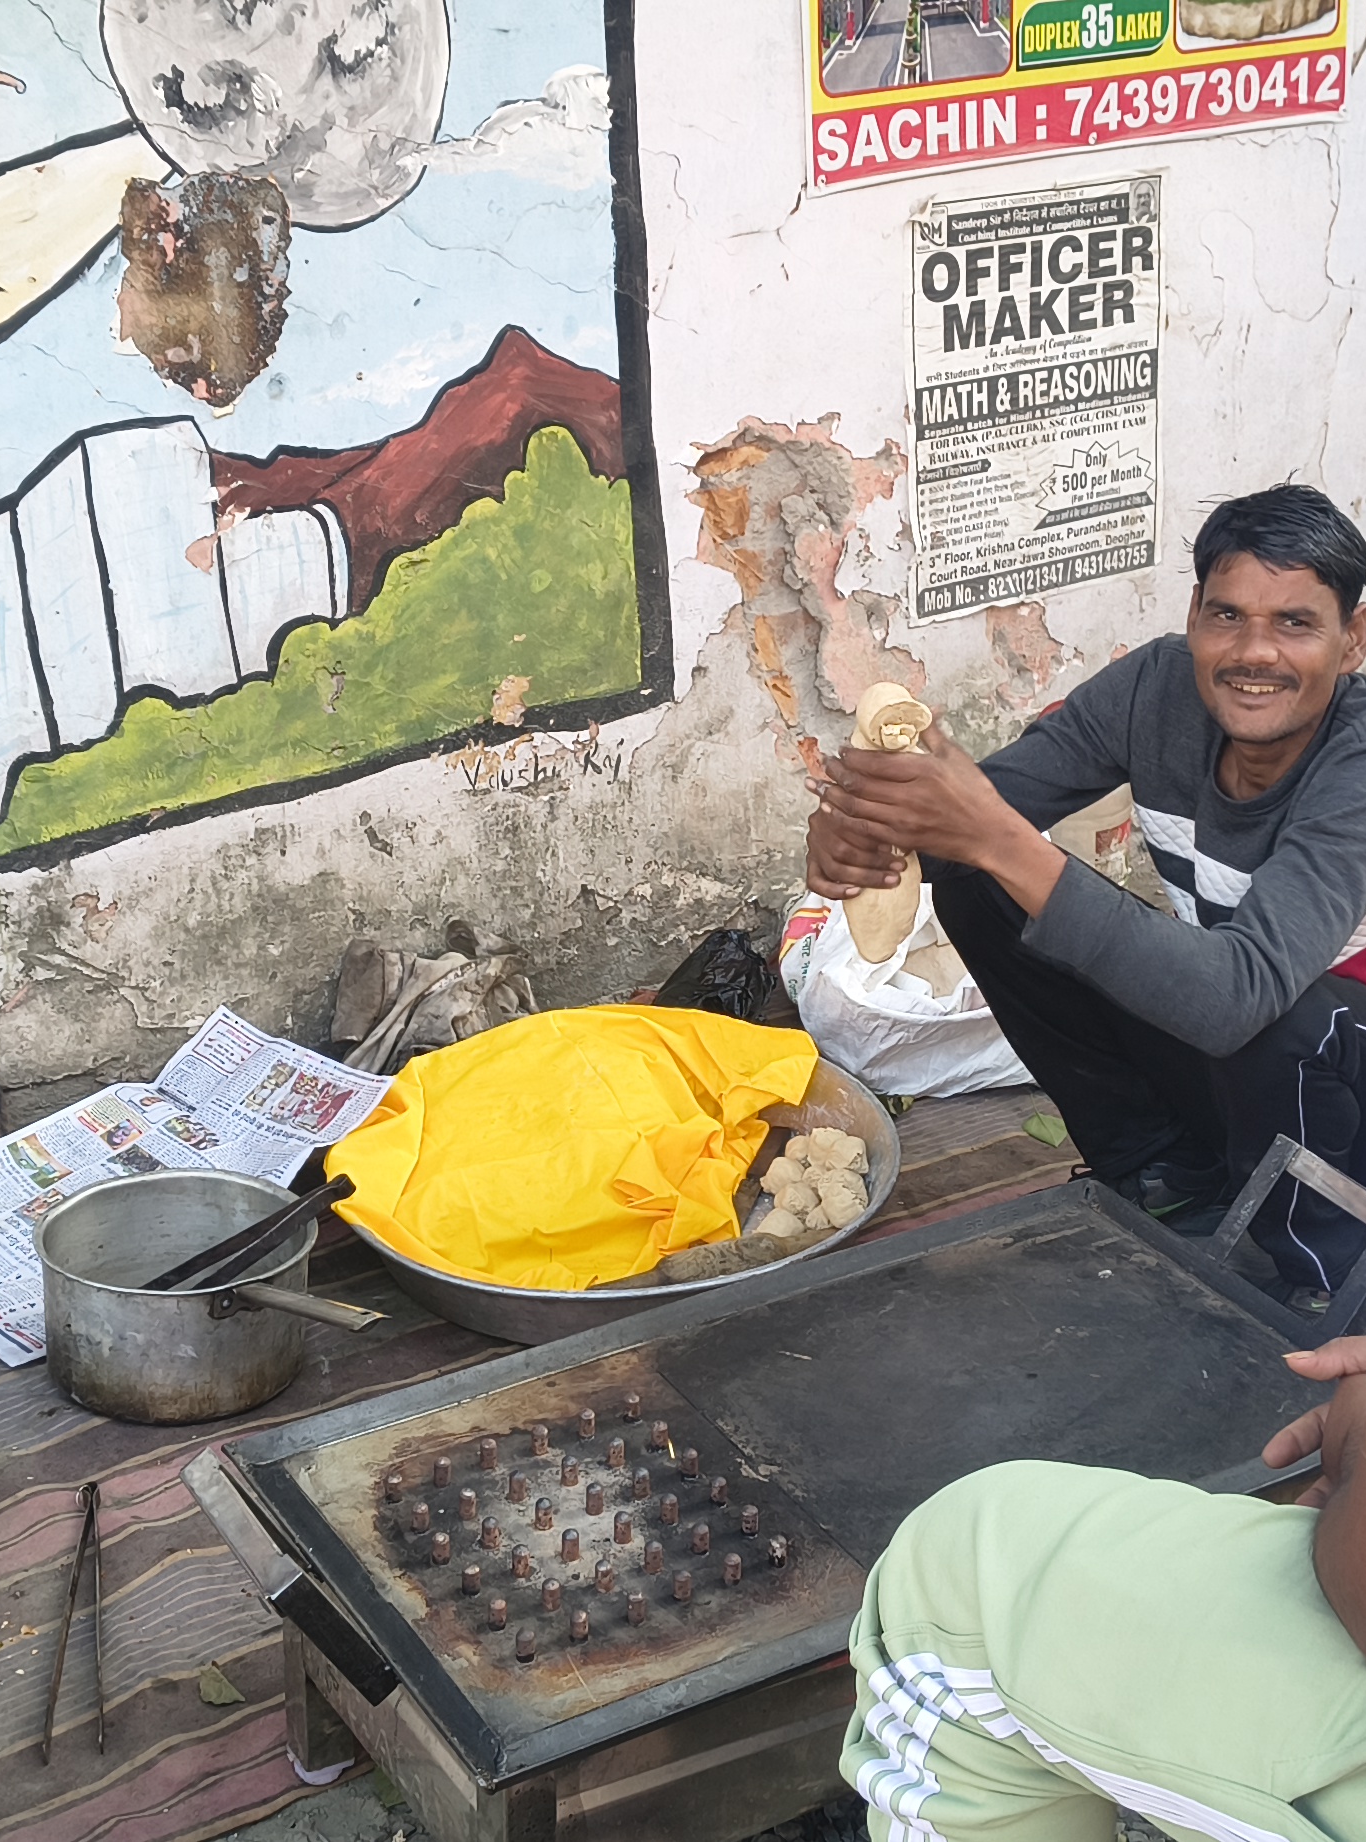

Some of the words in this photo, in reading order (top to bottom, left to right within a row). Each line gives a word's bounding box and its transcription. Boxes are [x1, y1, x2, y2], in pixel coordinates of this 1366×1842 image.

[1024, 30, 1081, 55] DUPLEX
[1080, 4, 1115, 50] 35
[1116, 11, 1162, 42] LAKH
[816, 96, 1018, 173] SACHIN
[1064, 54, 1341, 138] 7439730412
[952, 214, 987, 231] Sandeep
[921, 225, 1154, 302] OFFICER
[943, 279, 1135, 353] MAKER
[922, 380, 988, 425] MATH
[996, 377, 1012, 413] &
[1018, 353, 1152, 409] REASONING
[945, 366, 980, 381] Students
[930, 439, 950, 451] FOR
[953, 433, 979, 446] BANK
[1086, 451, 1107, 468] Only
[1062, 471, 1087, 493] 500
[1091, 473, 1107, 489] per
[1110, 464, 1142, 482] Month
[929, 569, 958, 584] Court
[961, 561, 991, 579] Road,
[994, 555, 1017, 570] Near
[1105, 528, 1146, 548] Deoghar
[944, 547, 973, 565] Floor,
[976, 539, 1016, 558] Krishna
[1018, 529, 1065, 550] Complex,
[1067, 518, 1118, 539] Purandaha
[1120, 512, 1146, 528] More
[924, 585, 951, 613] Mob
[956, 583, 976, 607] No.
[1075, 544, 1148, 578] 9431443755
